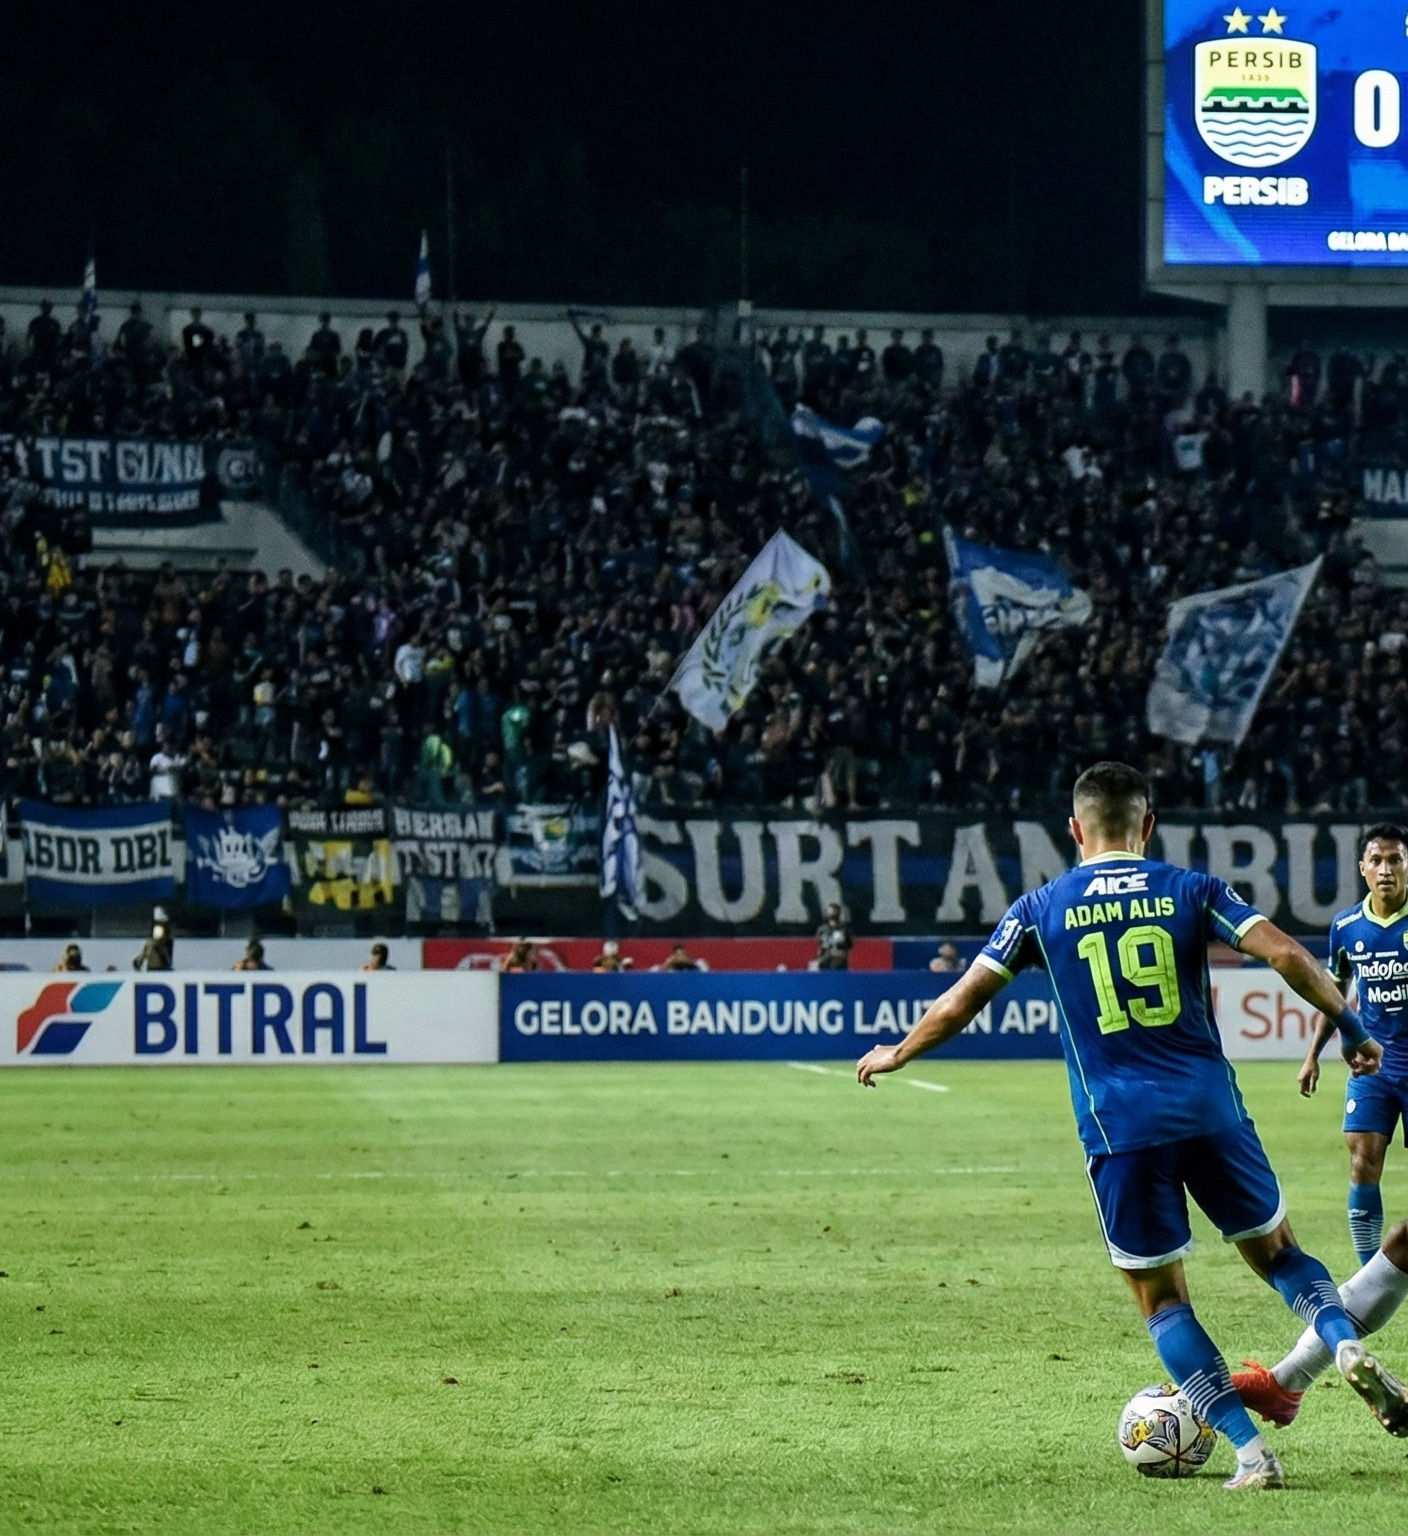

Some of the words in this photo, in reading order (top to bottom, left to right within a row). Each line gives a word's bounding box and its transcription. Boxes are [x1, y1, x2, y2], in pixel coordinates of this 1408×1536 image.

[1209, 51, 1302, 69] PERSIB
[1354, 69, 1400, 148] 0
[1203, 176, 1309, 206] PERSIB
[1083, 873, 1149, 897] AICE
[1065, 901, 1124, 930] ADAM
[1129, 896, 1175, 920] ALIS
[1077, 924, 1182, 1035] 19
[134, 982, 388, 1055] BITRAL
[514, 1000, 657, 1036] GELORA
[667, 1000, 844, 1036] BANDUNG
